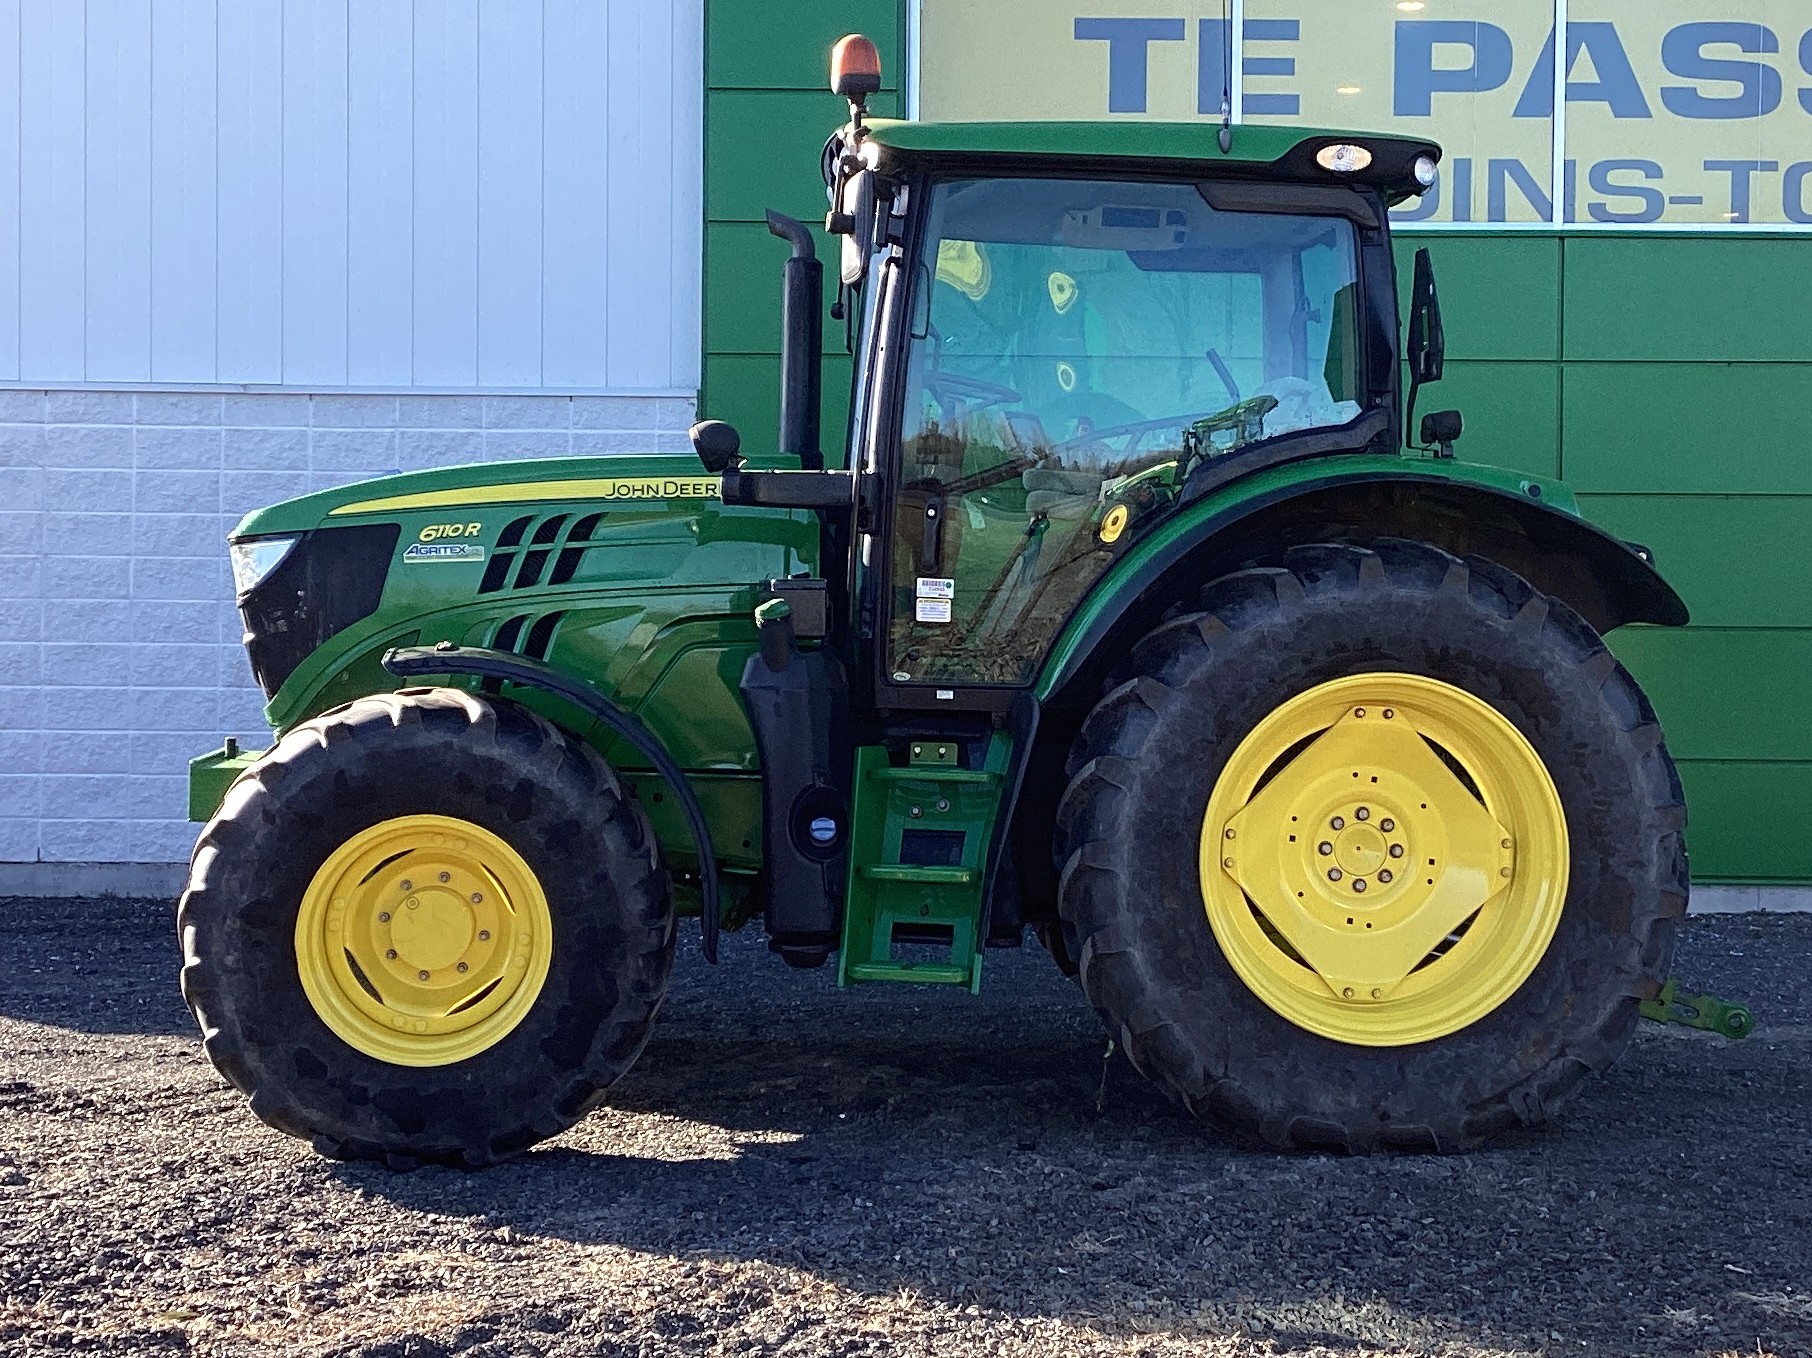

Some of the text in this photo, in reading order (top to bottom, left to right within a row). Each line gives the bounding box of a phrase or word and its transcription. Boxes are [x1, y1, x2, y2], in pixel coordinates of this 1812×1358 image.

[1074, 17, 1812, 119] TE PAS
[605, 481, 721, 496] JOHN DEER
